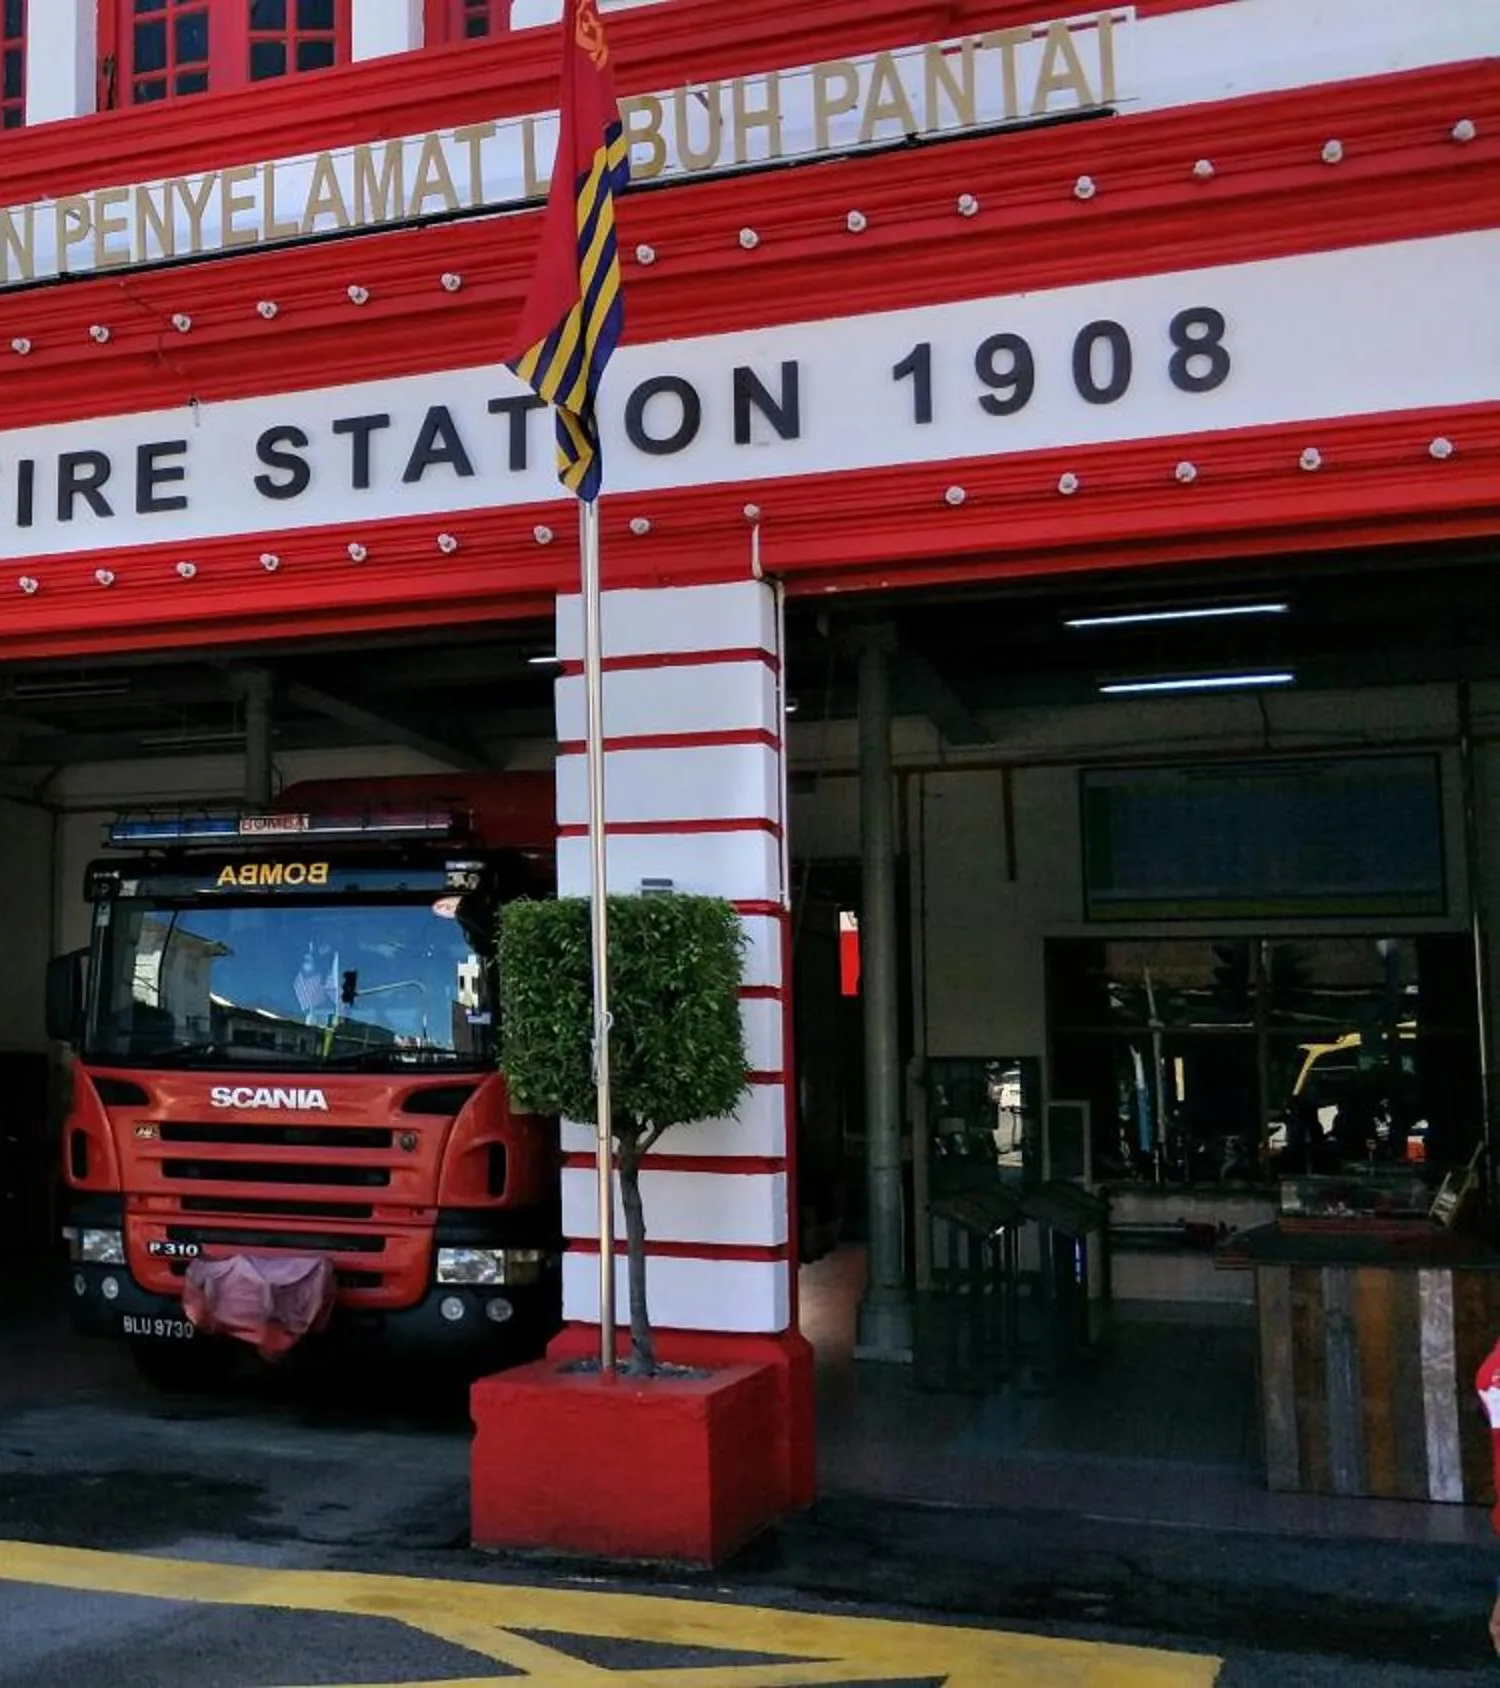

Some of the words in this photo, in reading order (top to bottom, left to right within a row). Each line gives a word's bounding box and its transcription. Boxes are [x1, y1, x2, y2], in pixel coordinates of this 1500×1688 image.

[56, 121, 497, 269] PENYELAMAT
[523, 70, 780, 195] LBUH
[812, 11, 1121, 150] PANTAI
[254, 360, 801, 500] STATON
[892, 306, 1231, 424] 1908
[210, 1087, 328, 1110] SCANIA
[164, 1243, 199, 1257] 310
